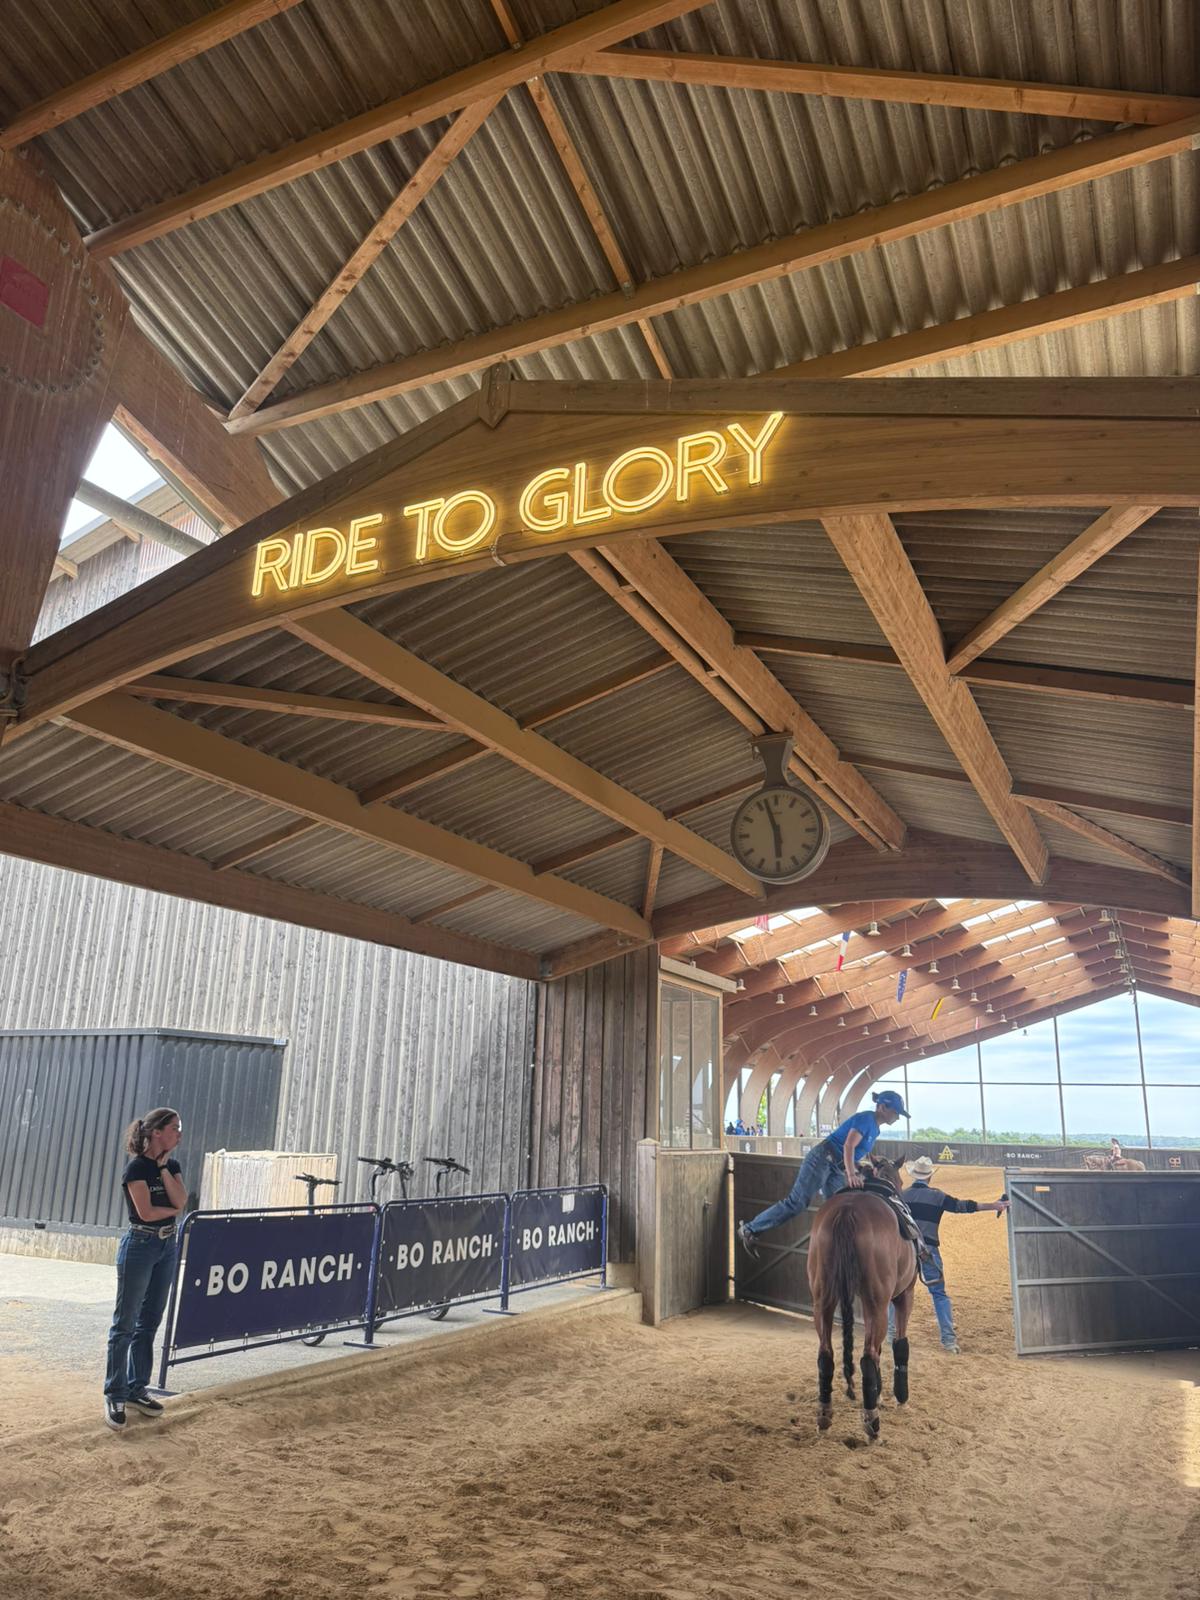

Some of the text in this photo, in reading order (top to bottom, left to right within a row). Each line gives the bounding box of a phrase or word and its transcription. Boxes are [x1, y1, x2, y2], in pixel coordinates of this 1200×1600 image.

[251, 411, 784, 597] RIDE TO GLORY
[396, 1234, 493, 1270] BO RANCH
[522, 1220, 594, 1251] BO RANCH
[206, 1253, 354, 1296] BO RANCH
